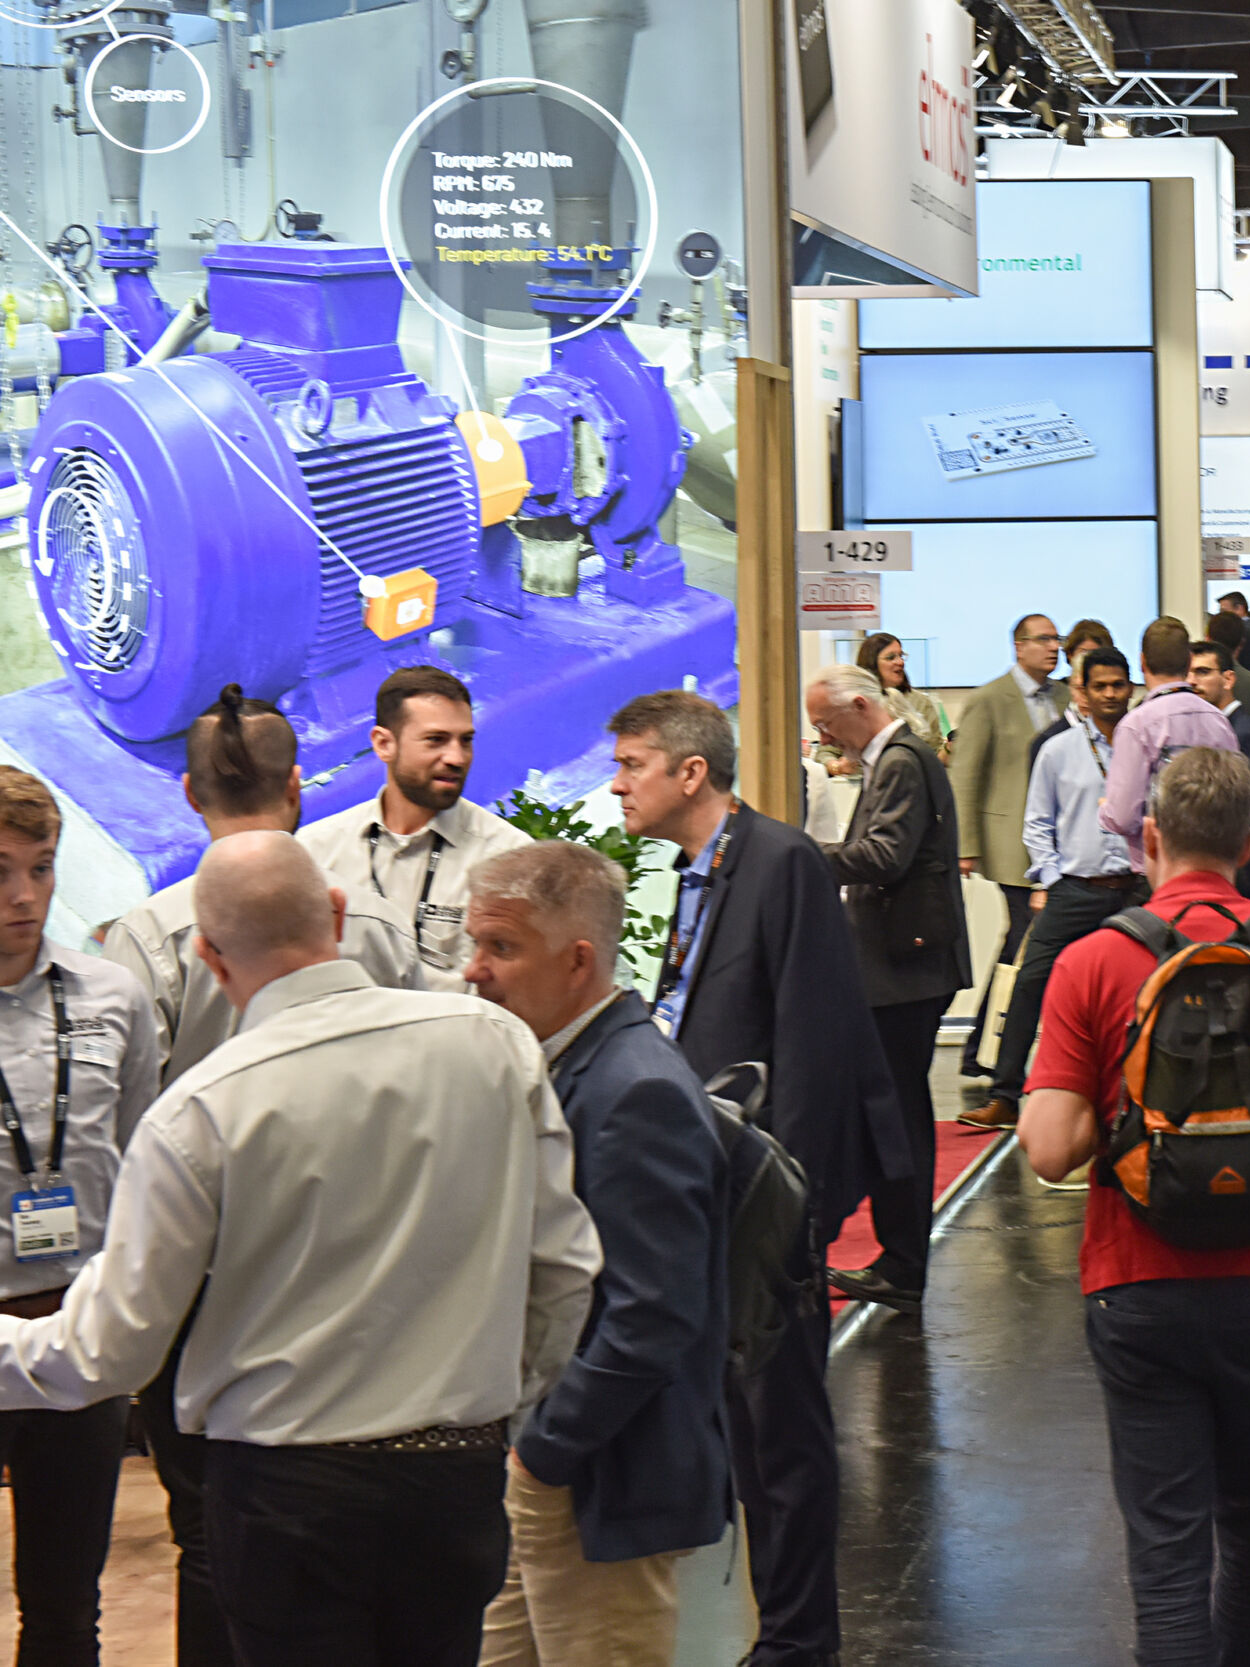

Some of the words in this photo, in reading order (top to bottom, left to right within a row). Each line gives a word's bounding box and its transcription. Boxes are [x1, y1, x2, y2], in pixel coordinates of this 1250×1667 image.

[110, 85, 186, 102] Sensors
[431, 151, 501, 171] Torque:
[502, 151, 540, 168] 240
[540, 152, 573, 168] Nm
[432, 175, 480, 192] RPM:
[481, 175, 516, 192] 675
[432, 199, 508, 219] Voltage:
[509, 198, 545, 215] 432
[433, 222, 510, 239] Current:
[435, 246, 555, 264] Temperature:
[978, 253, 1083, 272] onmental
[824, 541, 888, 562] 1-429
